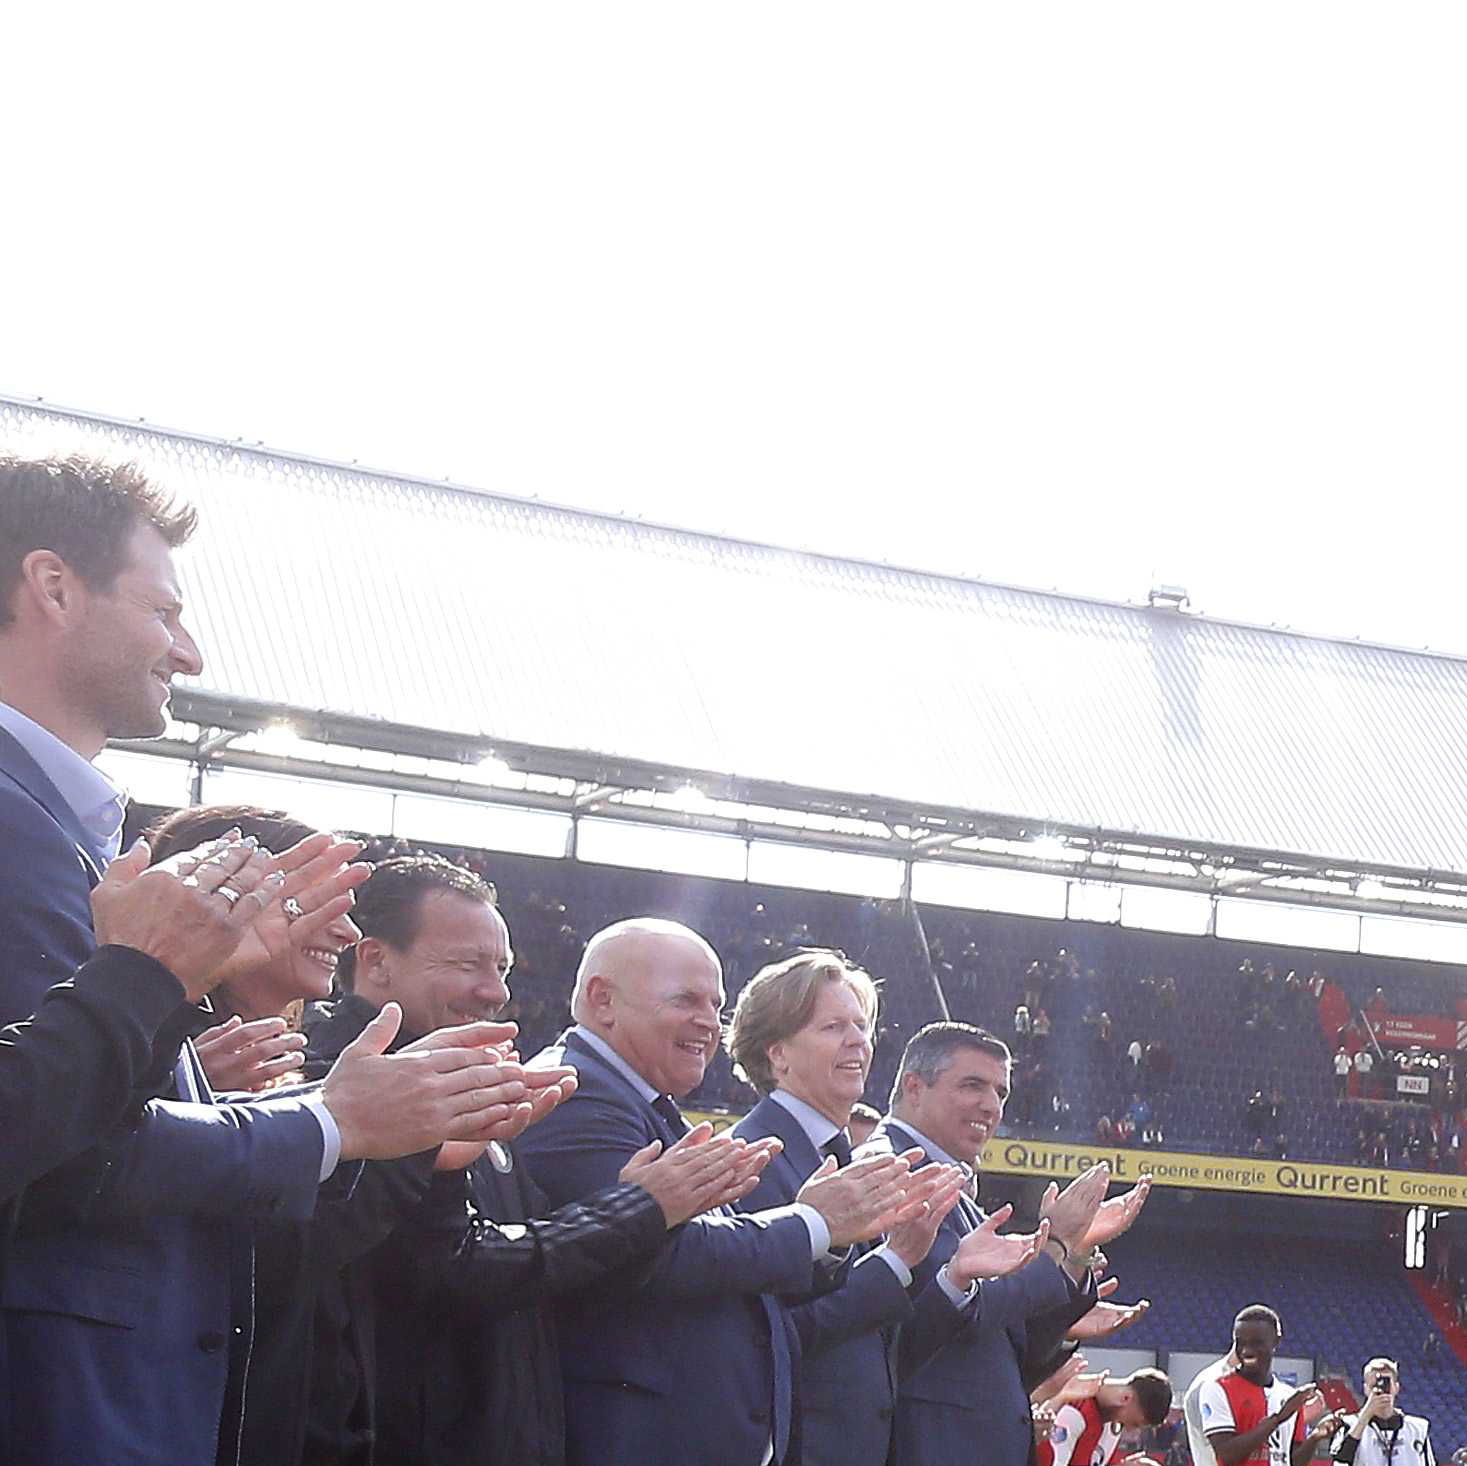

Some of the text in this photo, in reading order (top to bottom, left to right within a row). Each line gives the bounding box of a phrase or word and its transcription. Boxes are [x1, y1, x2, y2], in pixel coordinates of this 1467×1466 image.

[1137, 1161, 1200, 1179] Groene
[1204, 1168, 1266, 1186] energie
[1276, 1165, 1390, 1196] Qurrent
[1400, 1180, 1458, 1199] Groene
